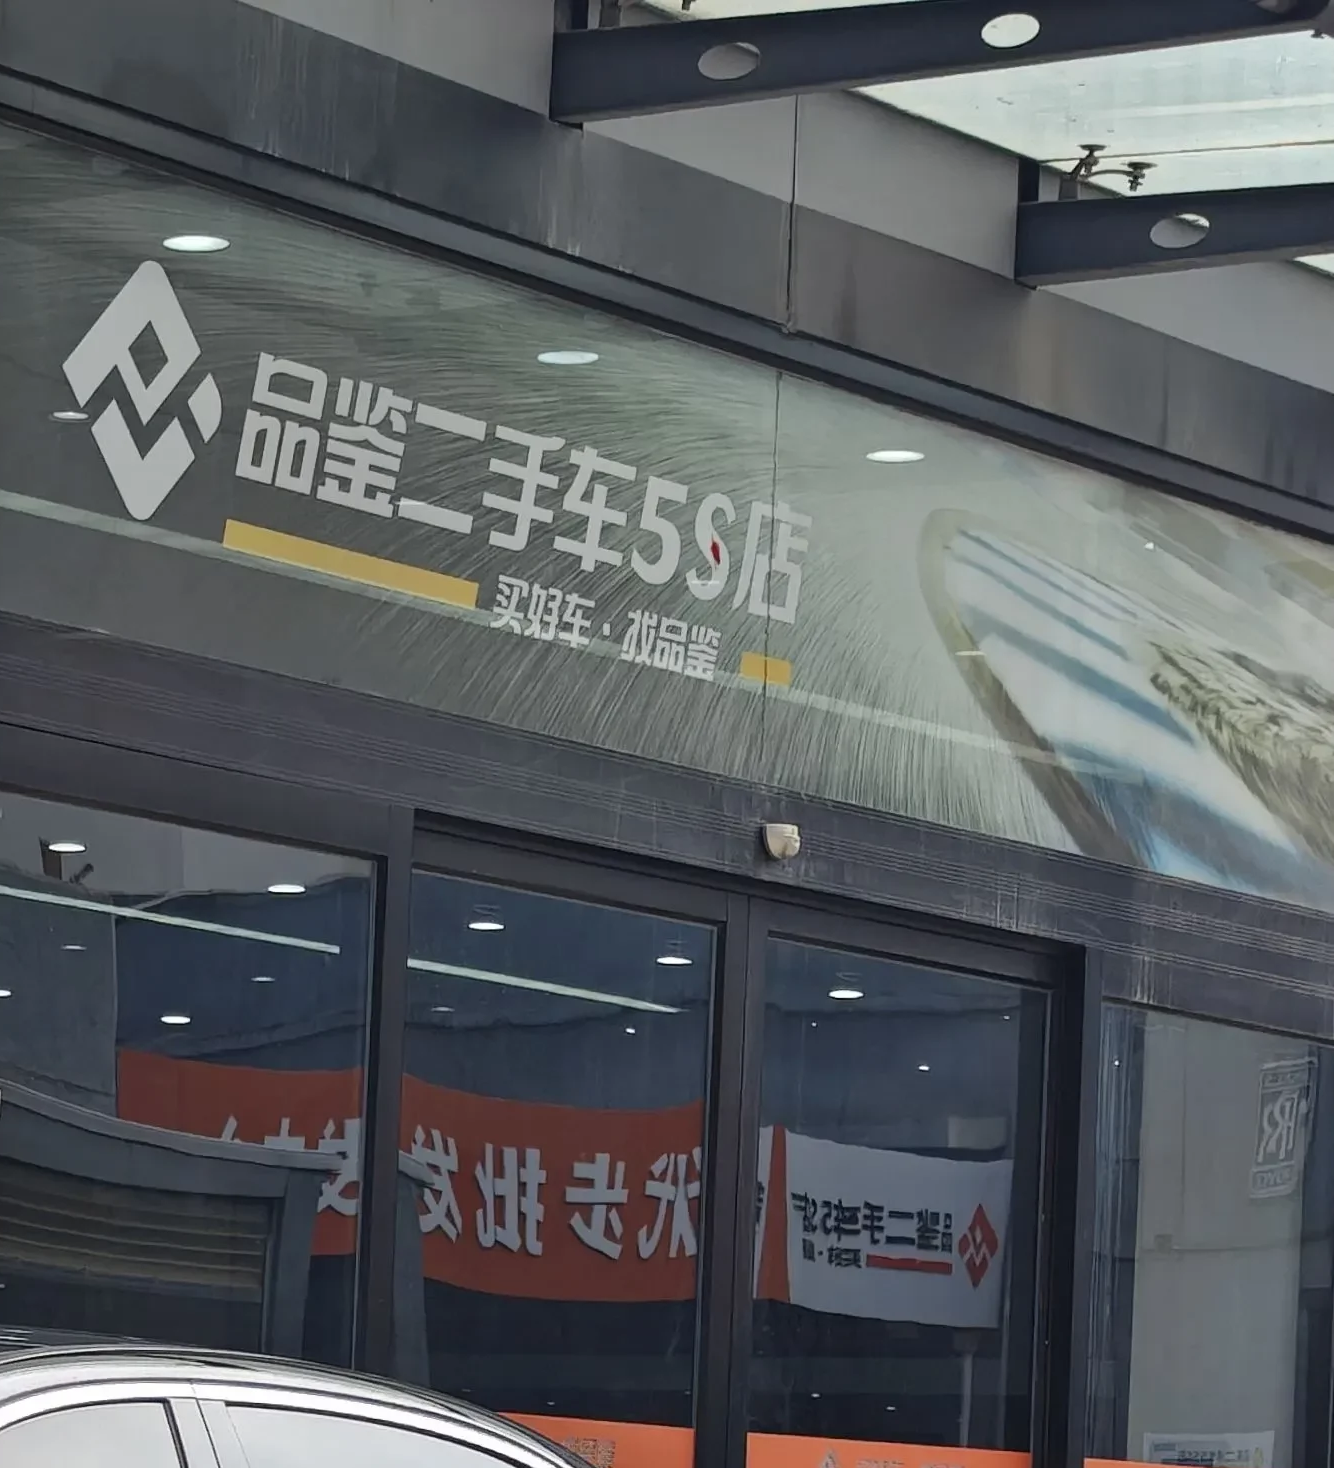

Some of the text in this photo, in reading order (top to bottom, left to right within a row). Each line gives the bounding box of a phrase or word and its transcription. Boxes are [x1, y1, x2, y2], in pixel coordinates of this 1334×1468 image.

[234, 351, 813, 625] 品鉴二手车5S店
